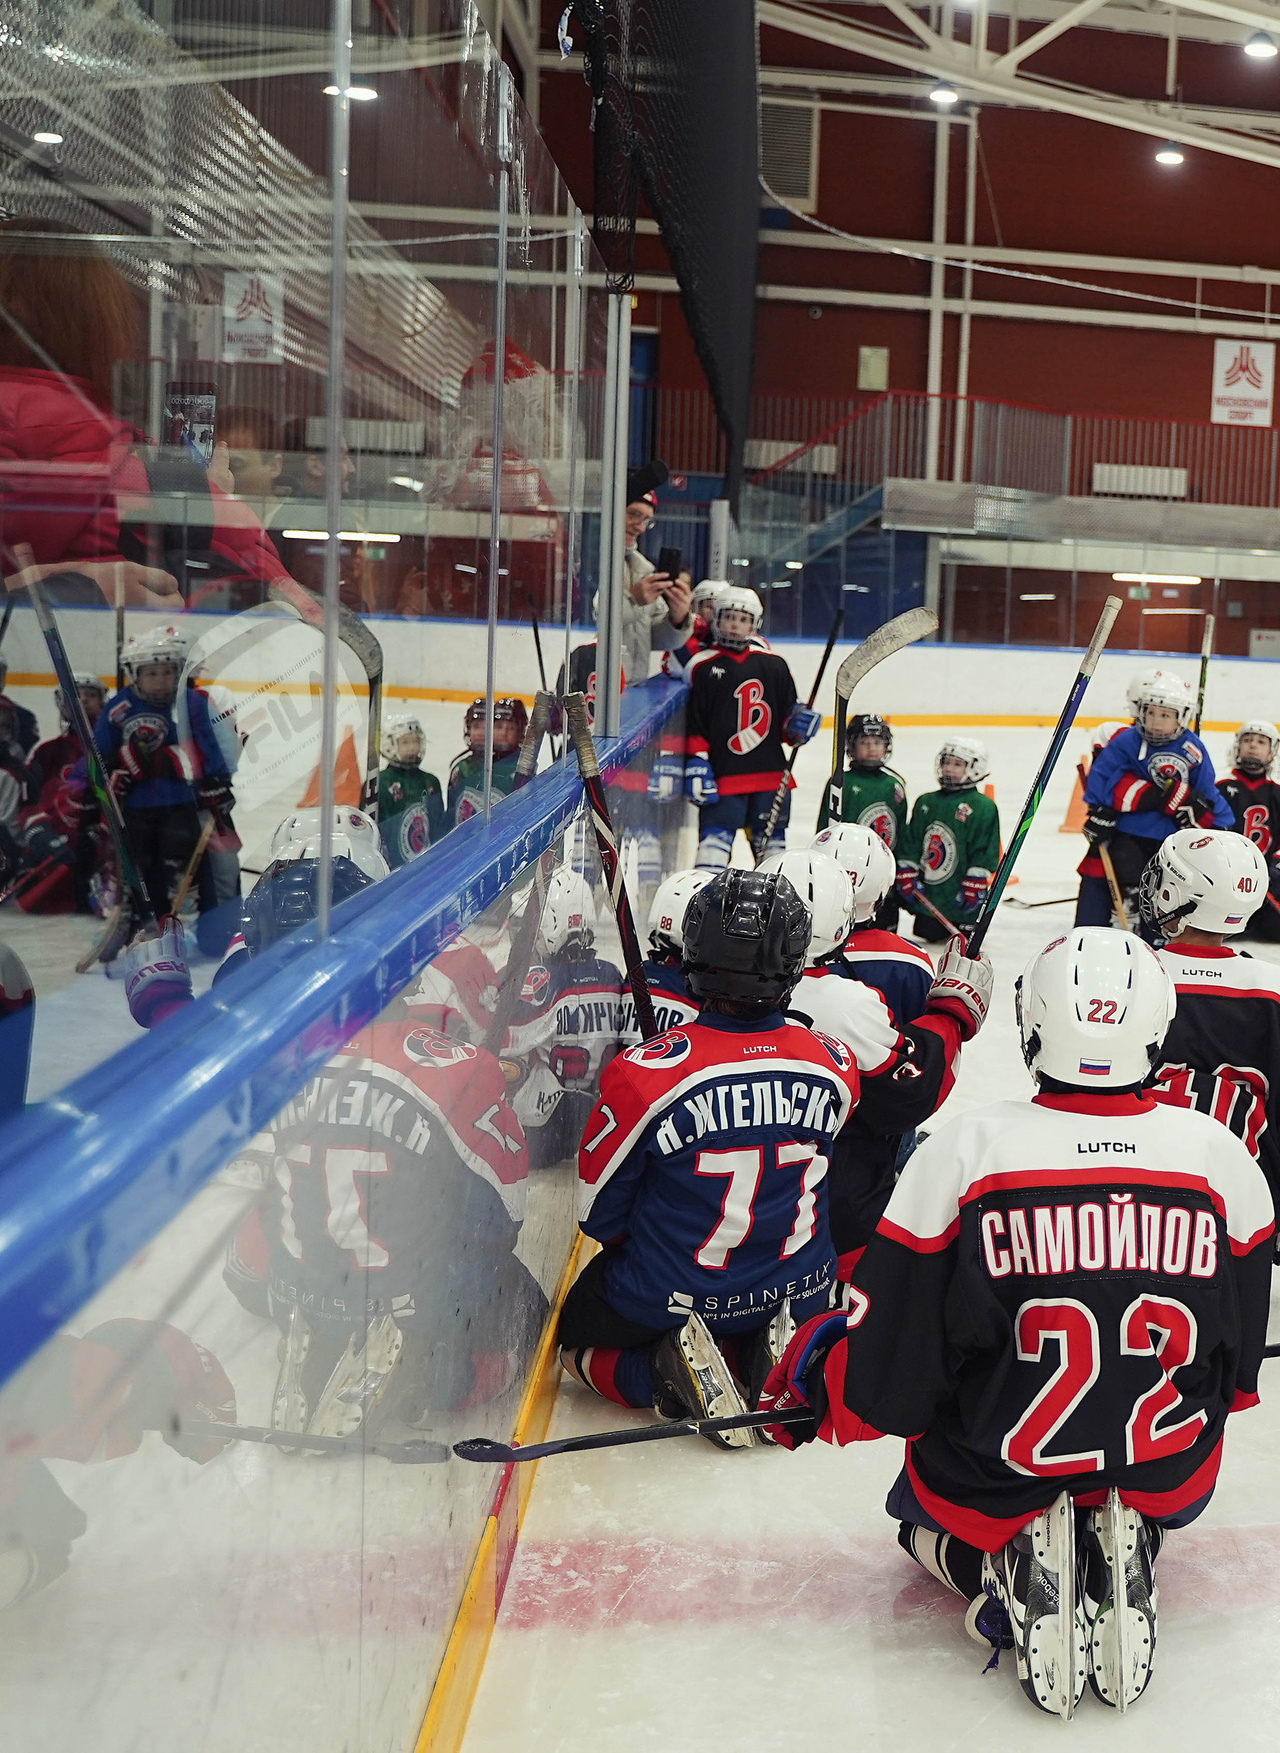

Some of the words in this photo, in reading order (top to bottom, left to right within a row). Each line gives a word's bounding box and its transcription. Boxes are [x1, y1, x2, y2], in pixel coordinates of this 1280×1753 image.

[1169, 866, 1187, 882] BAUER
[1237, 877, 1252, 894] 40
[660, 915, 673, 931] 88
[1182, 968, 1222, 978] LUTCH
[1087, 998, 1118, 1025] 22
[743, 1045, 777, 1054] LUTCH
[1078, 1142, 1136, 1154] LUTCH
[693, 1139, 830, 1270] 77
[981, 1193, 1218, 1279] САМОЙЛОВ
[704, 1259, 832, 1310] SPINETIX
[720, 1311, 731, 1319] IN
[733, 1306, 766, 1318] DIGITAL
[1001, 1293, 1208, 1477] 22
